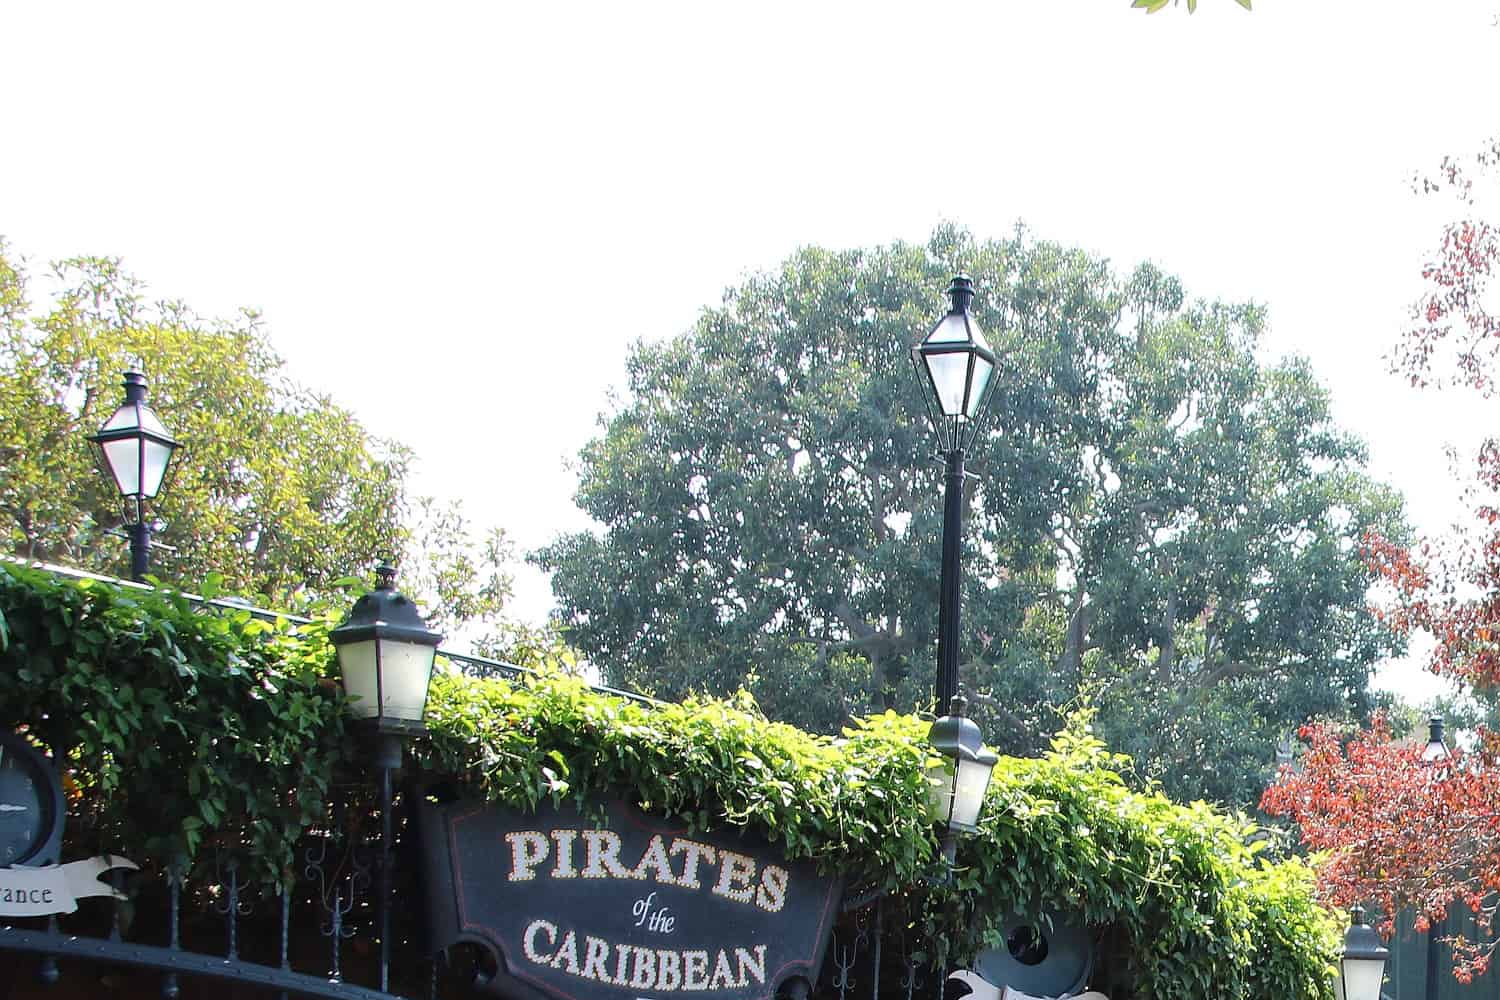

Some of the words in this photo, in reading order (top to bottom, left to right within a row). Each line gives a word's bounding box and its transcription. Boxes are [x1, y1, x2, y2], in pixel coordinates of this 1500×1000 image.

[0, 888, 53, 903] ance
[504, 829, 790, 912] PIRATES
[632, 891, 657, 926] of
[649, 907, 675, 934] the
[523, 919, 768, 991] CARIBBEAN
